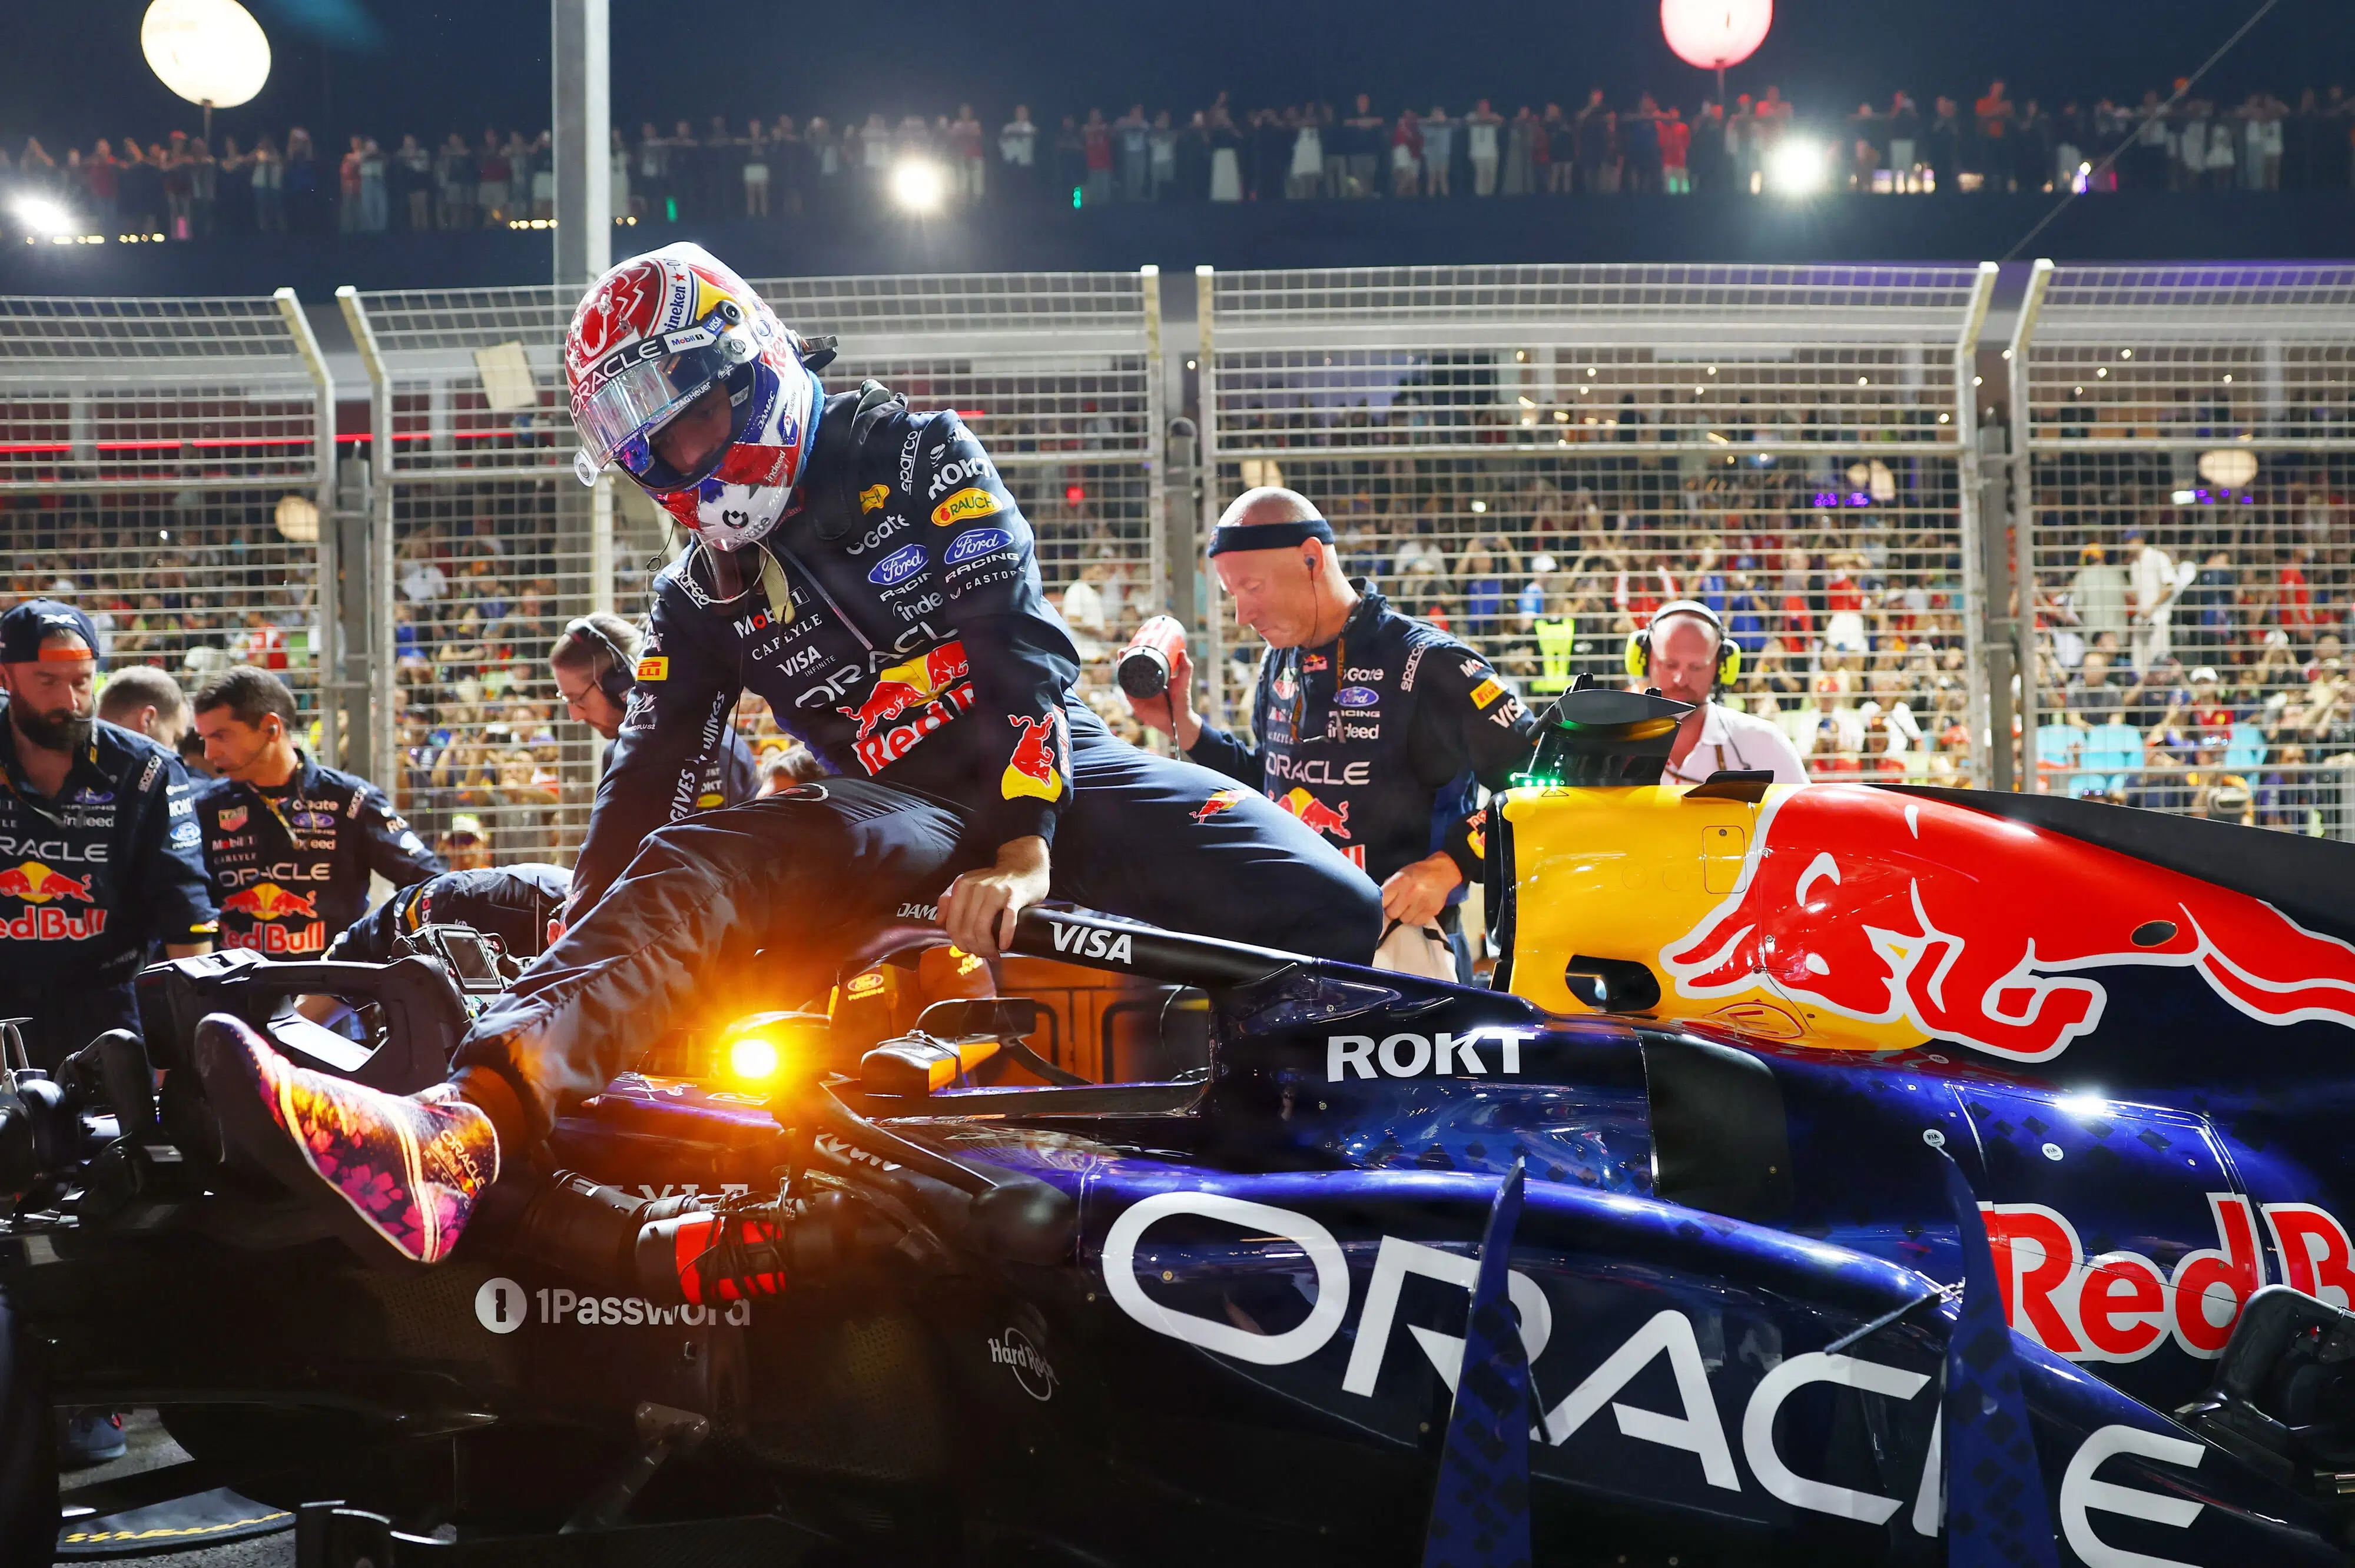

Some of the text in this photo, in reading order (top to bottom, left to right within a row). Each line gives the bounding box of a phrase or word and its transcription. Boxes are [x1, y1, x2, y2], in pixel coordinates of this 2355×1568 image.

[664, 286, 686, 332] ineken
[706, 316, 723, 331] VISA
[671, 335, 696, 346] Mobil
[570, 340, 661, 417] ORACLE
[757, 391, 775, 430] DAMAC
[764, 450, 786, 483] indeed
[950, 497, 994, 516] RAUCH
[954, 532, 999, 559] Ford
[881, 549, 924, 582] Ford
[945, 552, 1020, 583] RACING
[671, 566, 711, 610] parco
[733, 591, 803, 639] Mob 1
[893, 592, 943, 622] inde
[775, 645, 822, 677] VISA
[804, 655, 836, 677] INFINITE
[1401, 642, 1428, 692] sparco
[1488, 697, 1527, 729] VIS
[669, 690, 725, 822] GIVES WINGS
[1266, 751, 1371, 786] ORACLE
[0, 836, 109, 862] RACLE
[422, 883, 438, 925] Mobi
[38, 907, 108, 941] Bull
[265, 920, 326, 954] Bull
[1049, 921, 1133, 965] VISA
[1326, 1031, 1536, 1082] ROKT
[440, 1130, 486, 1190] ORACLE
[1976, 1192, 2266, 1364] Red
[987, 1338, 1027, 1367] Hard
[1102, 1191, 2206, 1568] ORACE
